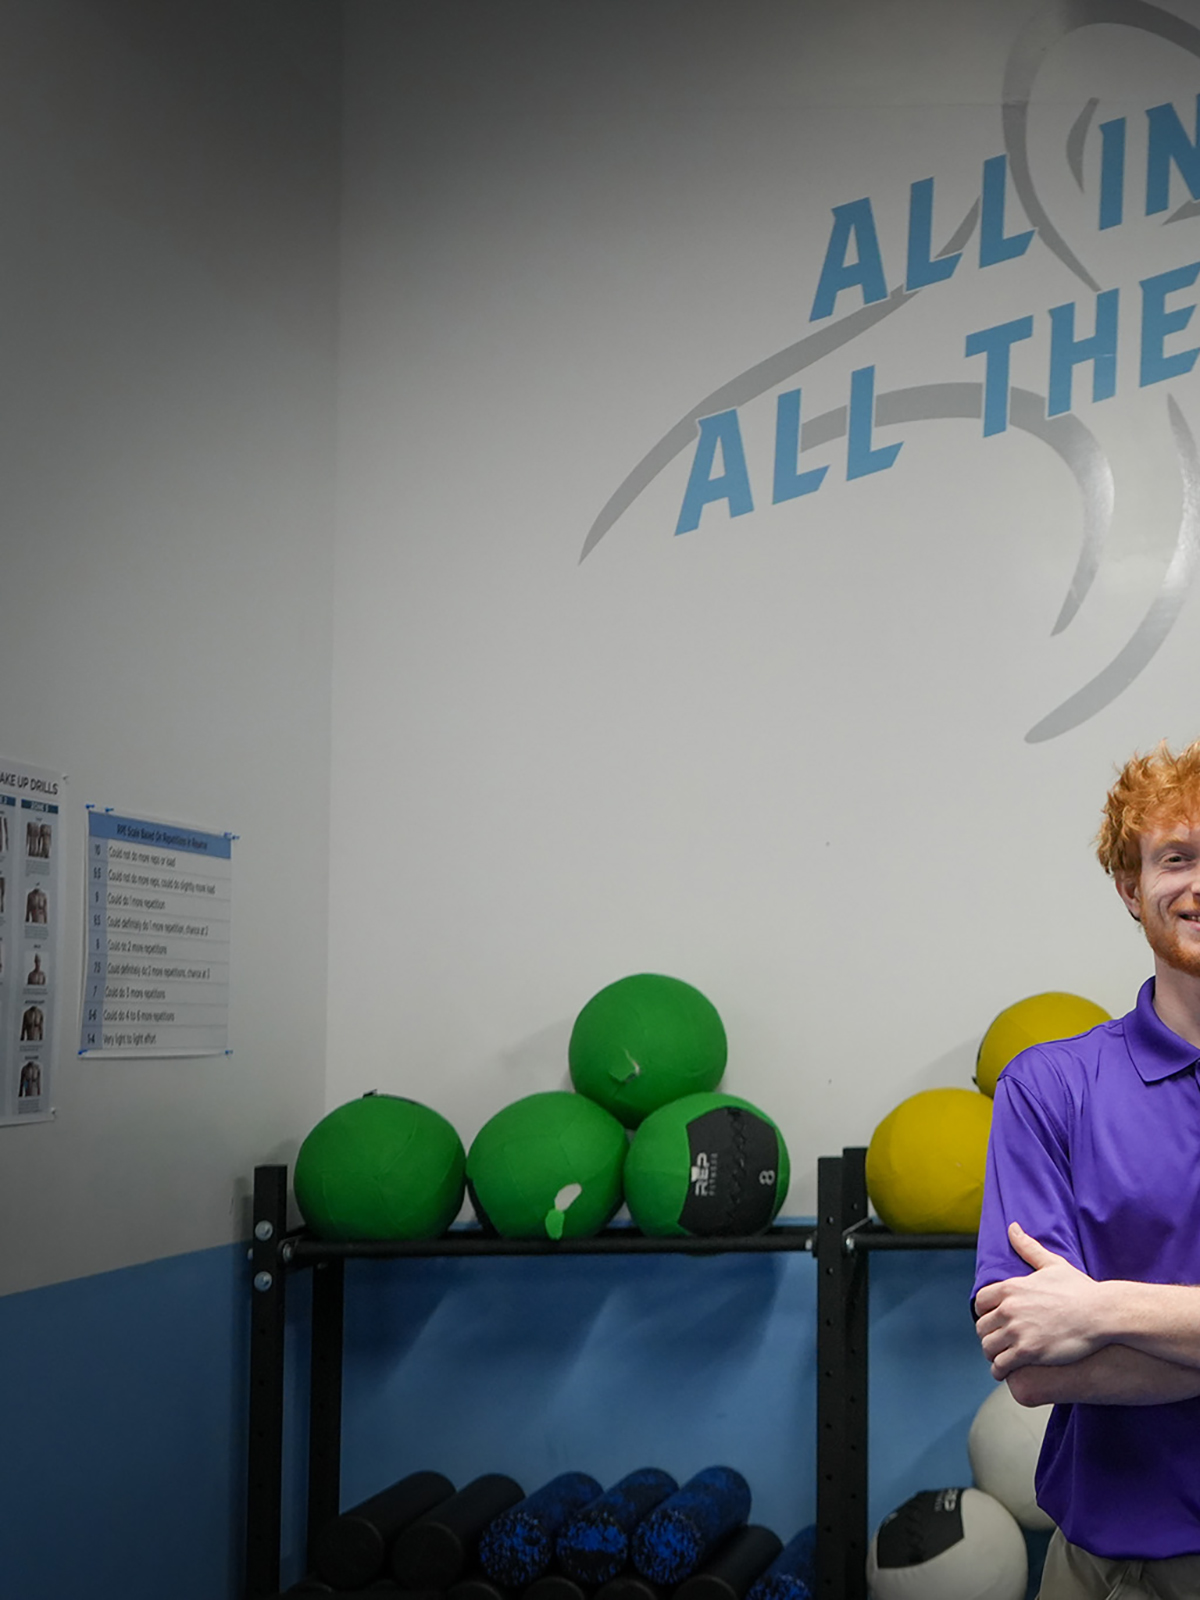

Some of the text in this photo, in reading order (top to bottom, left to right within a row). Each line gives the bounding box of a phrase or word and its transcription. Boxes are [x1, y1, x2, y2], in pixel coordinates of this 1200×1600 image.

[809, 153, 1037, 322] ALL
[673, 363, 904, 536] ALL
[17, 775, 29, 788] UP
[30, 778, 59, 796] DRILLS
[758, 1169, 776, 1186] 8
